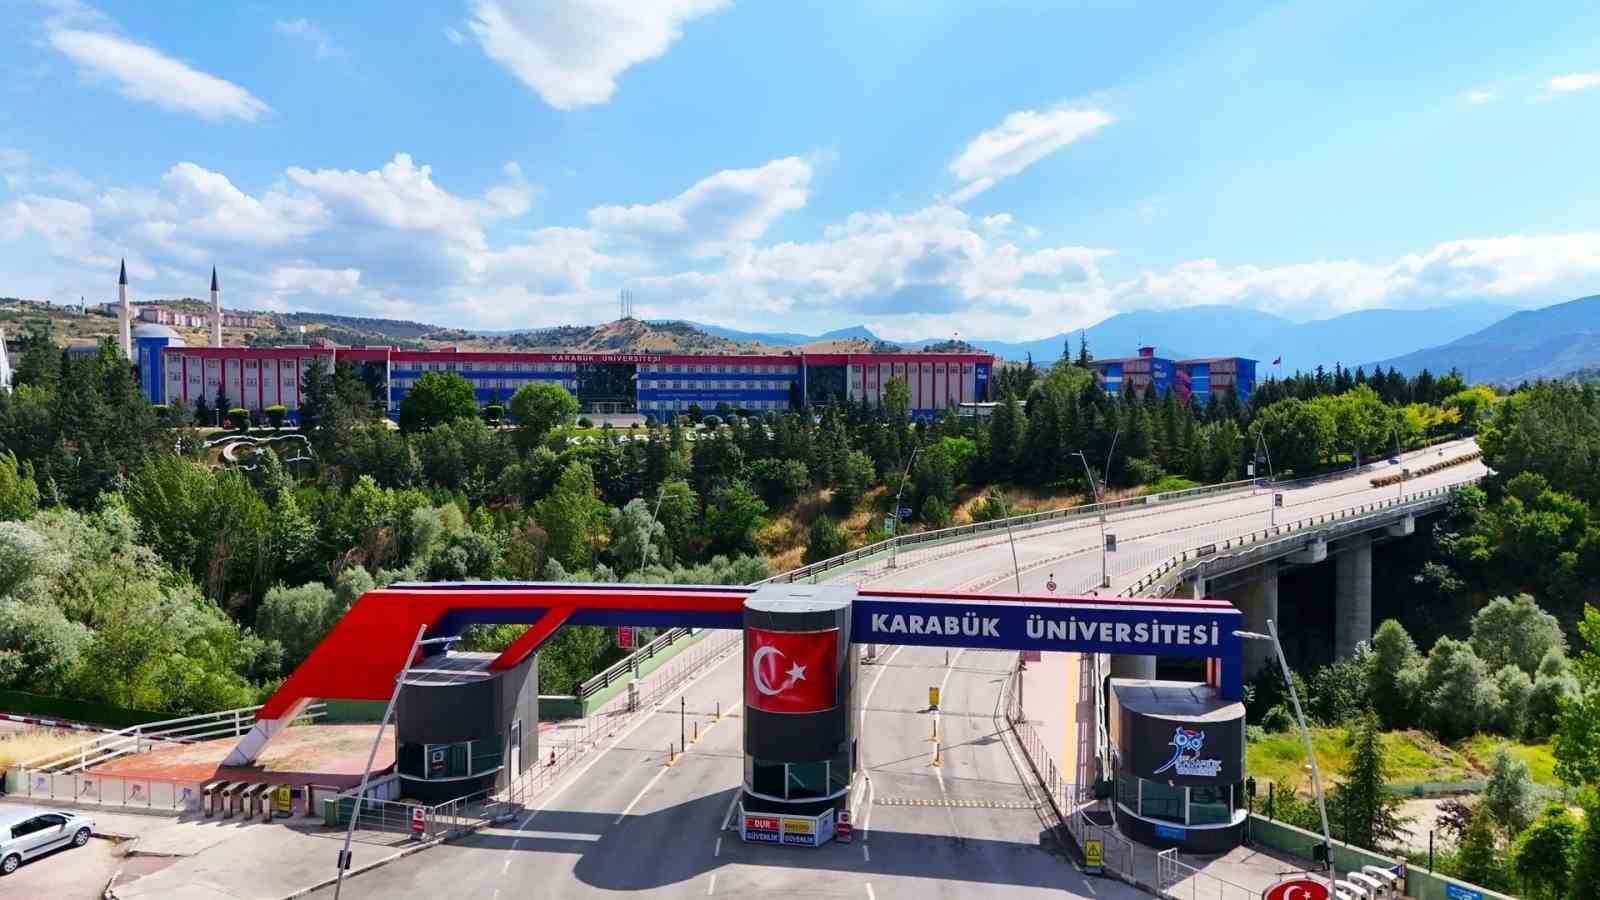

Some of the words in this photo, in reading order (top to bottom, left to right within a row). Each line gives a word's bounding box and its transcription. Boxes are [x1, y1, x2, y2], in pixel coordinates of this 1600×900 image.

[872, 611, 1000, 637] KARABÜK
[1026, 614, 1219, 646] ÜNİVERSİTESİ
[754, 819, 770, 829] DUR
